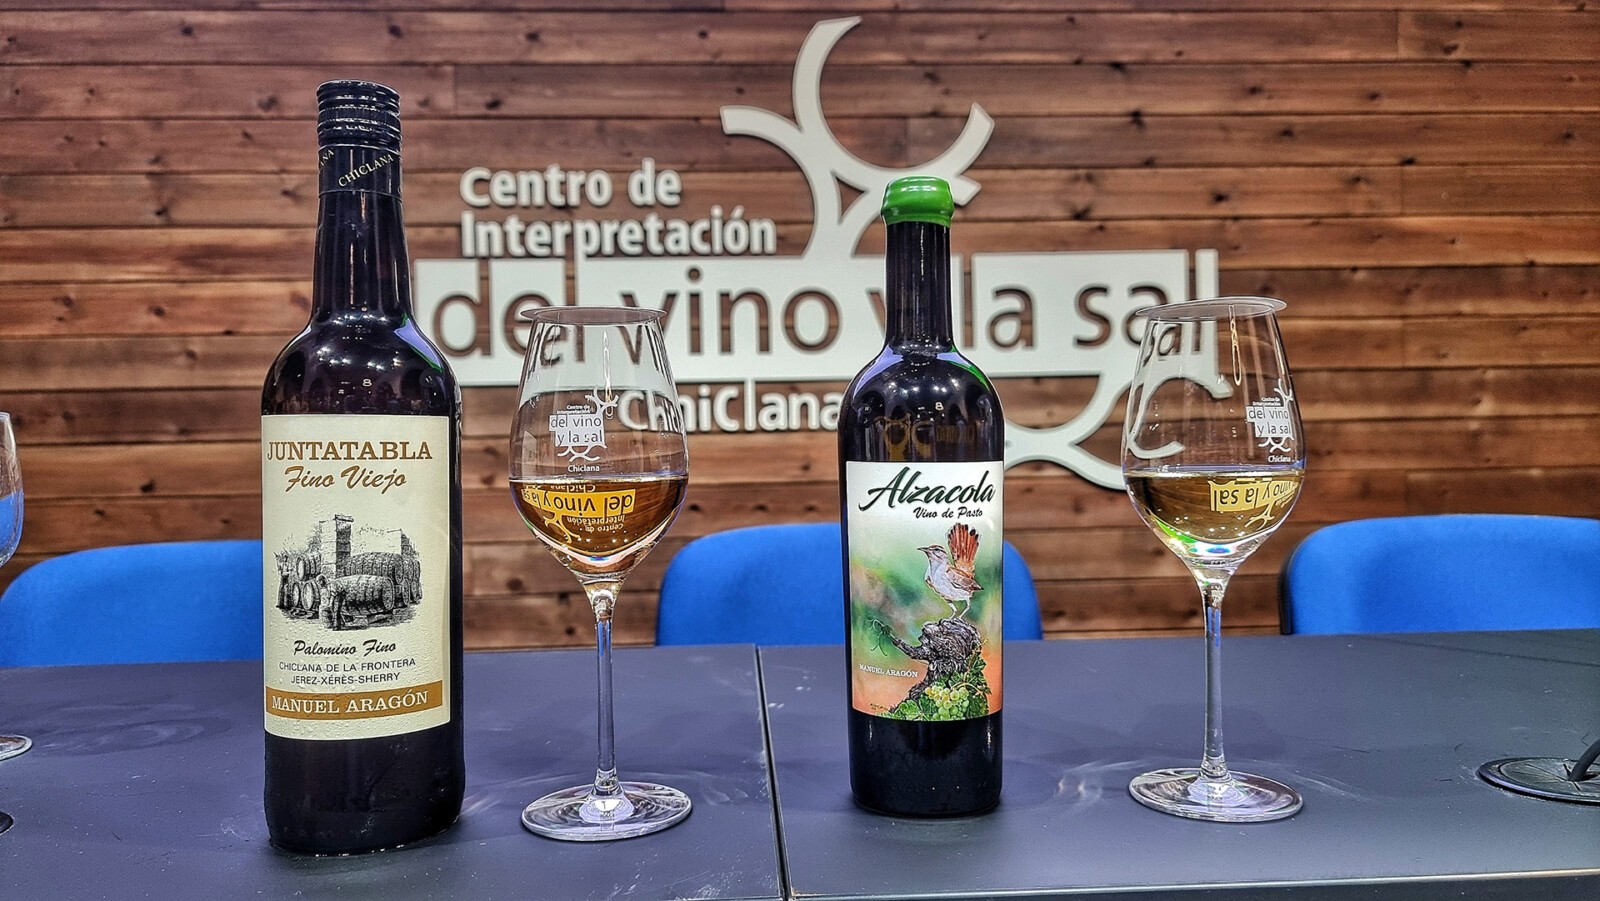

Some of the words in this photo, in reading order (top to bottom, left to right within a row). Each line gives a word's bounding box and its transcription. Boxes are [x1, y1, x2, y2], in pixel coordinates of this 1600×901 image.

[338, 154, 394, 187] CHICLANA
[628, 157, 682, 206] de
[461, 205, 777, 258] Interpretación
[621, 266, 842, 362] vino
[550, 414, 568, 428] del
[572, 415, 602, 428] vino
[1248, 405, 1266, 419] del
[1269, 407, 1289, 419] vino
[557, 434, 565, 447] y
[568, 430, 580, 443] la
[584, 429, 603, 443] sal
[1257, 425, 1265, 437] y
[1267, 421, 1277, 434] la
[1279, 421, 1291, 434] sal
[267, 441, 433, 461] JUNTATABLA
[284, 465, 336, 493] Fino
[340, 465, 408, 495] Viejo
[858, 466, 996, 512] Alzacola
[912, 506, 938, 519] Vino
[941, 507, 954, 518] de
[957, 506, 984, 519] Pasto
[293, 639, 358, 656] Palomino
[362, 639, 397, 657] Fino
[278, 661, 323, 673] CHICLANA
[326, 663, 340, 672] DE
[343, 663, 358, 672] LA
[361, 658, 416, 671] FRONTERA
[859, 664, 885, 675] MANUEL
[885, 669, 918, 678] ARAGÓN
[291, 672, 401, 685] JEREZ-XÉRÈS-SHERRY
[272, 695, 340, 714] MANUEL
[345, 690, 429, 713] ARAGÓN
